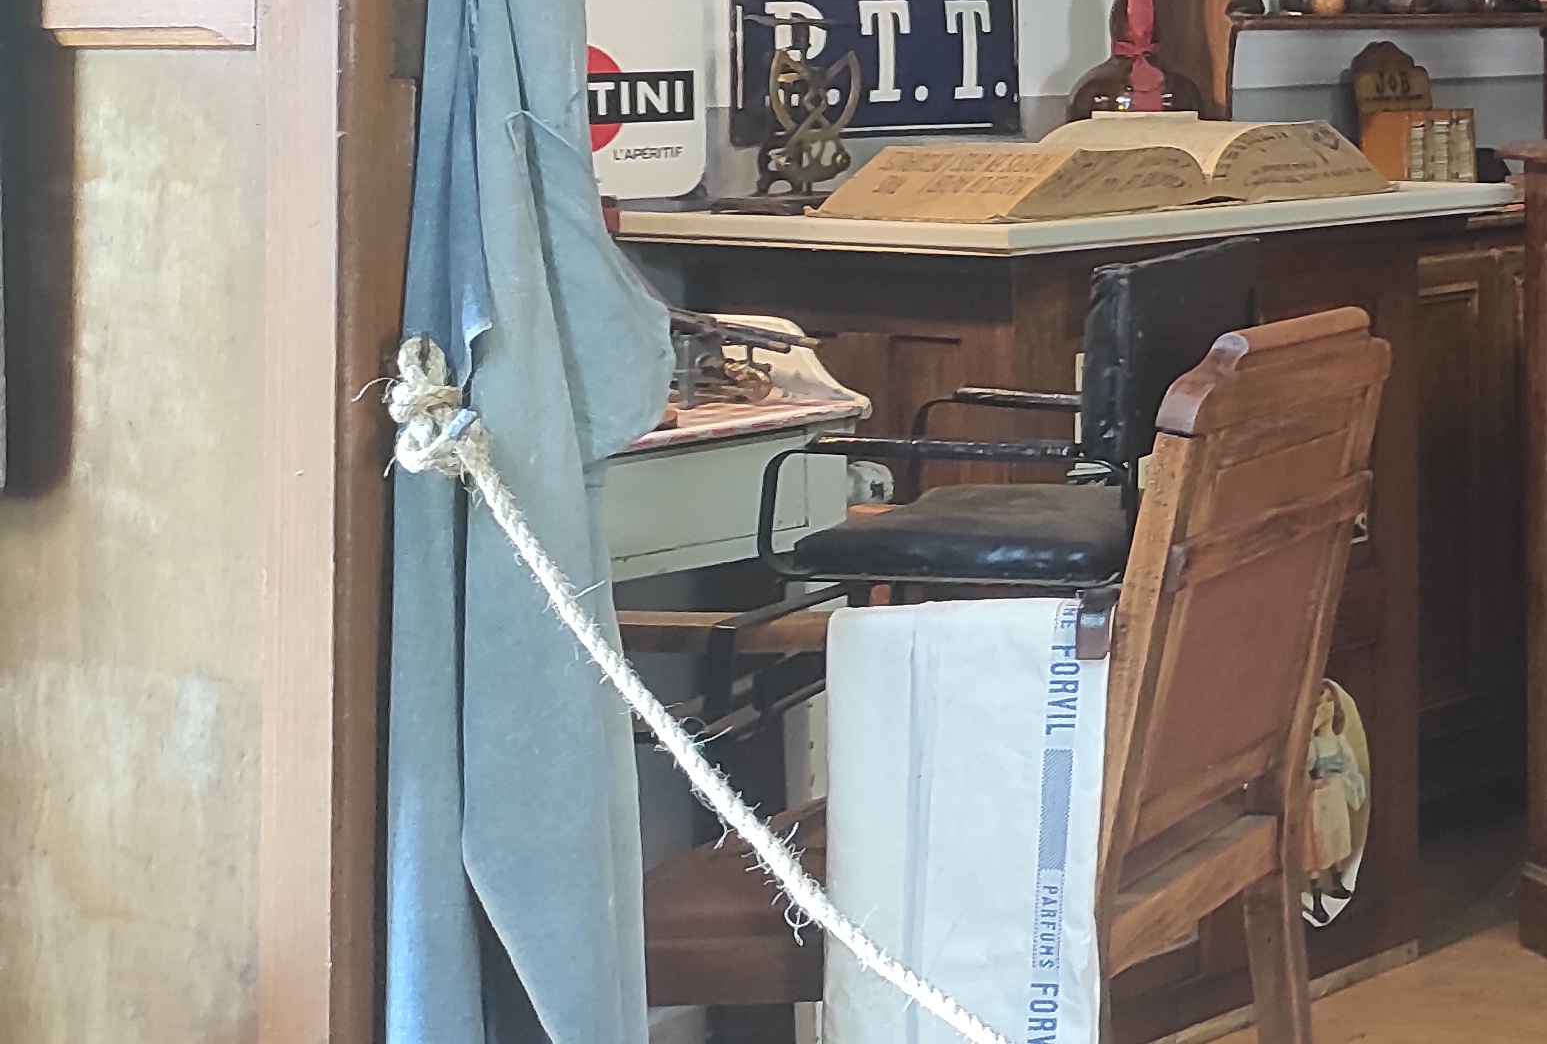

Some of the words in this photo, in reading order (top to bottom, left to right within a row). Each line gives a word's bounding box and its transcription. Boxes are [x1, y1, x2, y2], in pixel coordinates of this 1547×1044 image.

[765, 0, 1008, 106] P.T.T.
[1045, 645, 1081, 735] FORVIL
[1039, 885, 1060, 969] PARFUMS
